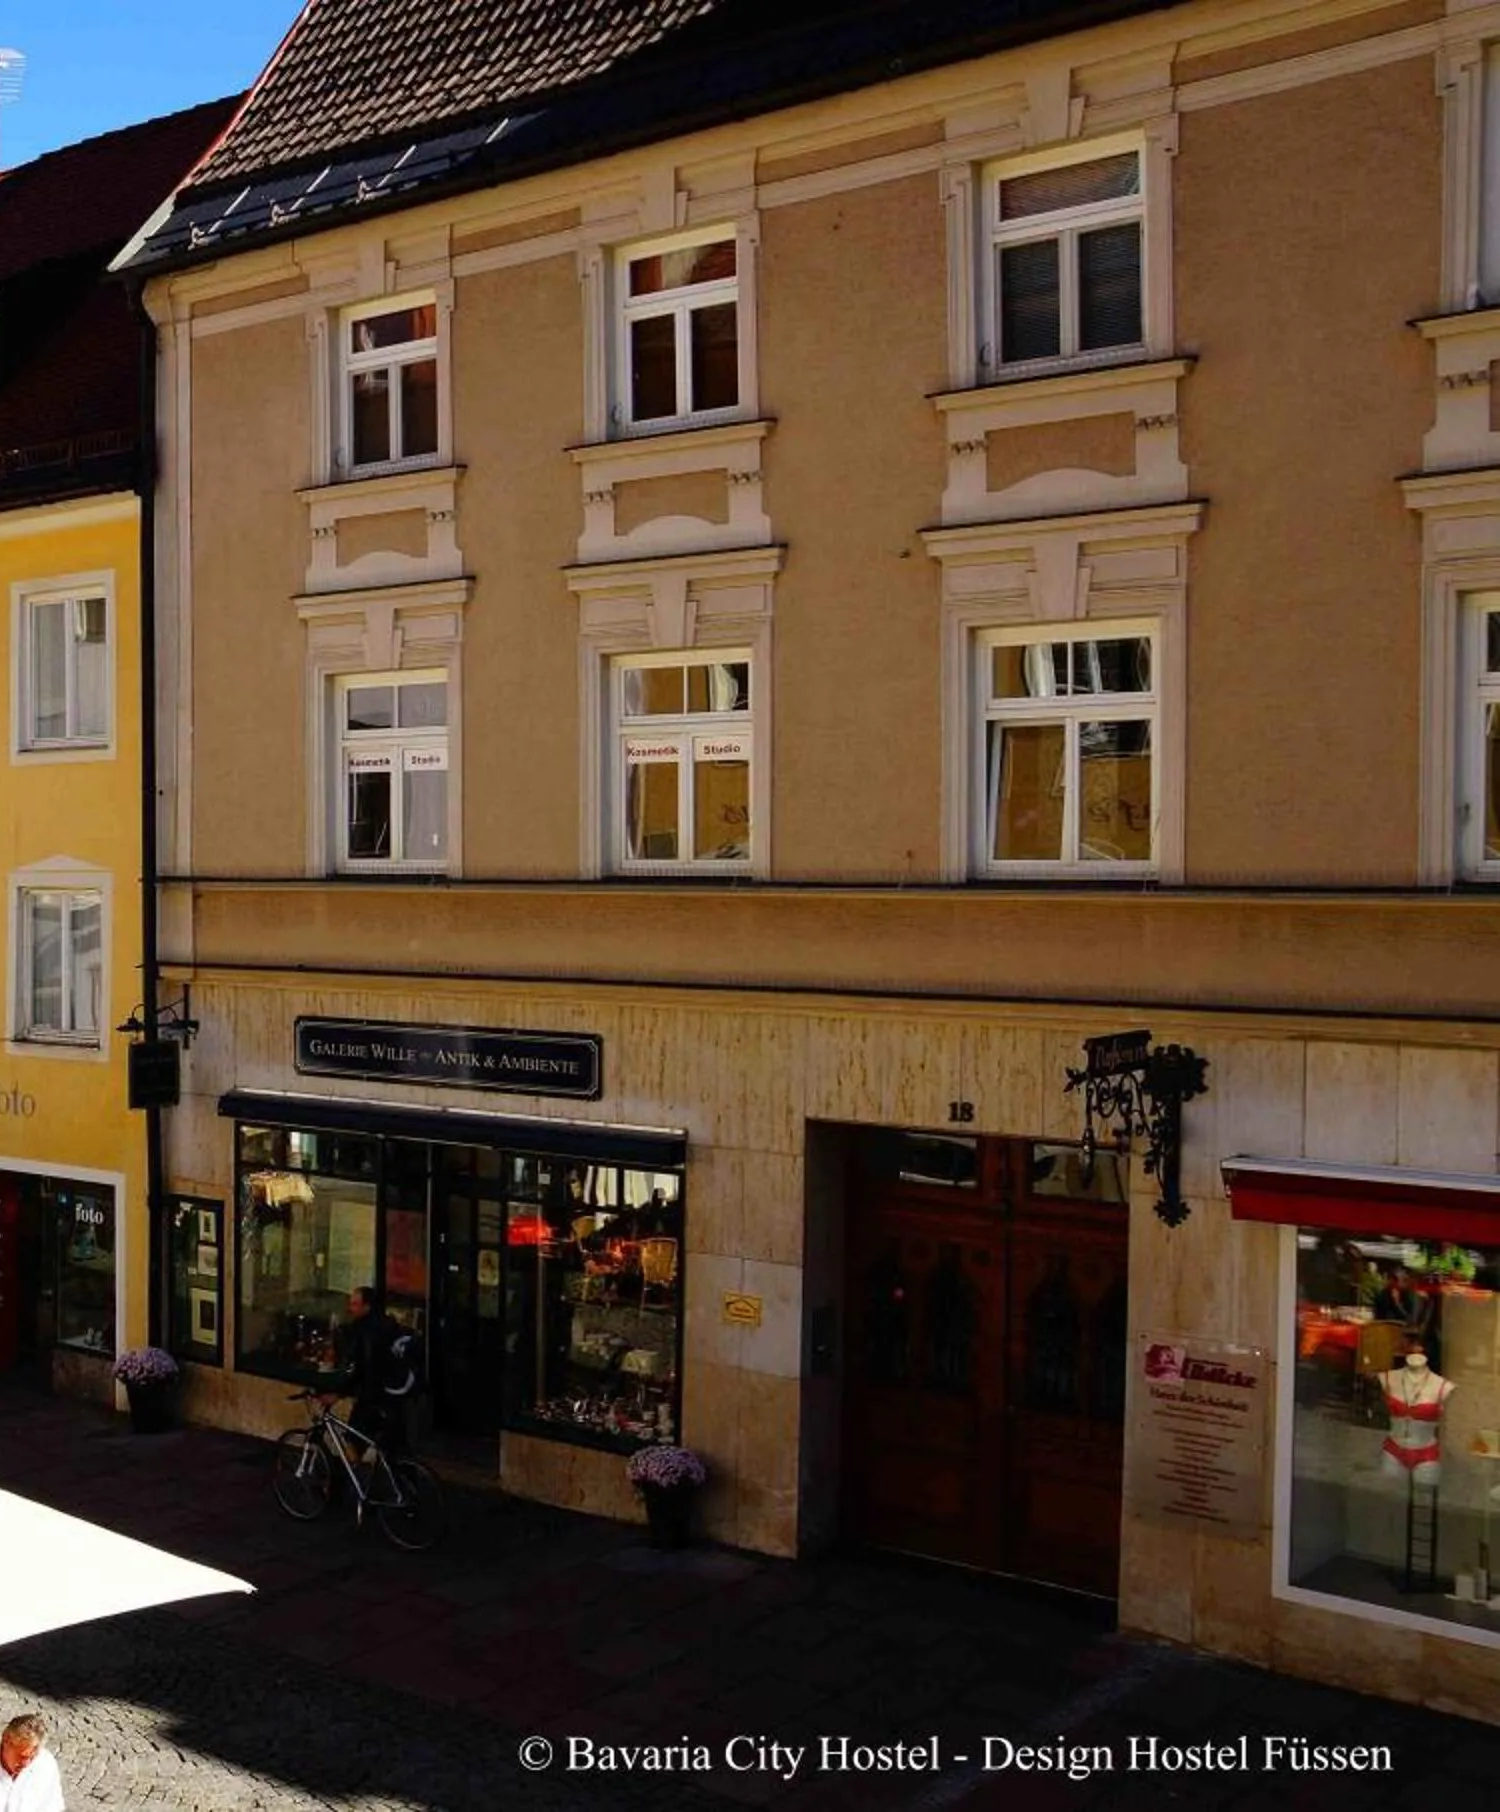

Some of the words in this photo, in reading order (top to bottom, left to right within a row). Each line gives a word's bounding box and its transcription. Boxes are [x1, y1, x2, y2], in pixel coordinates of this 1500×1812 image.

[626, 746, 679, 757] Kosmetik
[703, 744, 741, 755] Studio
[309, 1038, 366, 1059] GALERIE
[372, 1042, 416, 1063] WILLE
[434, 1049, 480, 1068] ANTIK
[499, 1055, 581, 1076] AMBIENTE
[75, 1203, 104, 1225] foto
